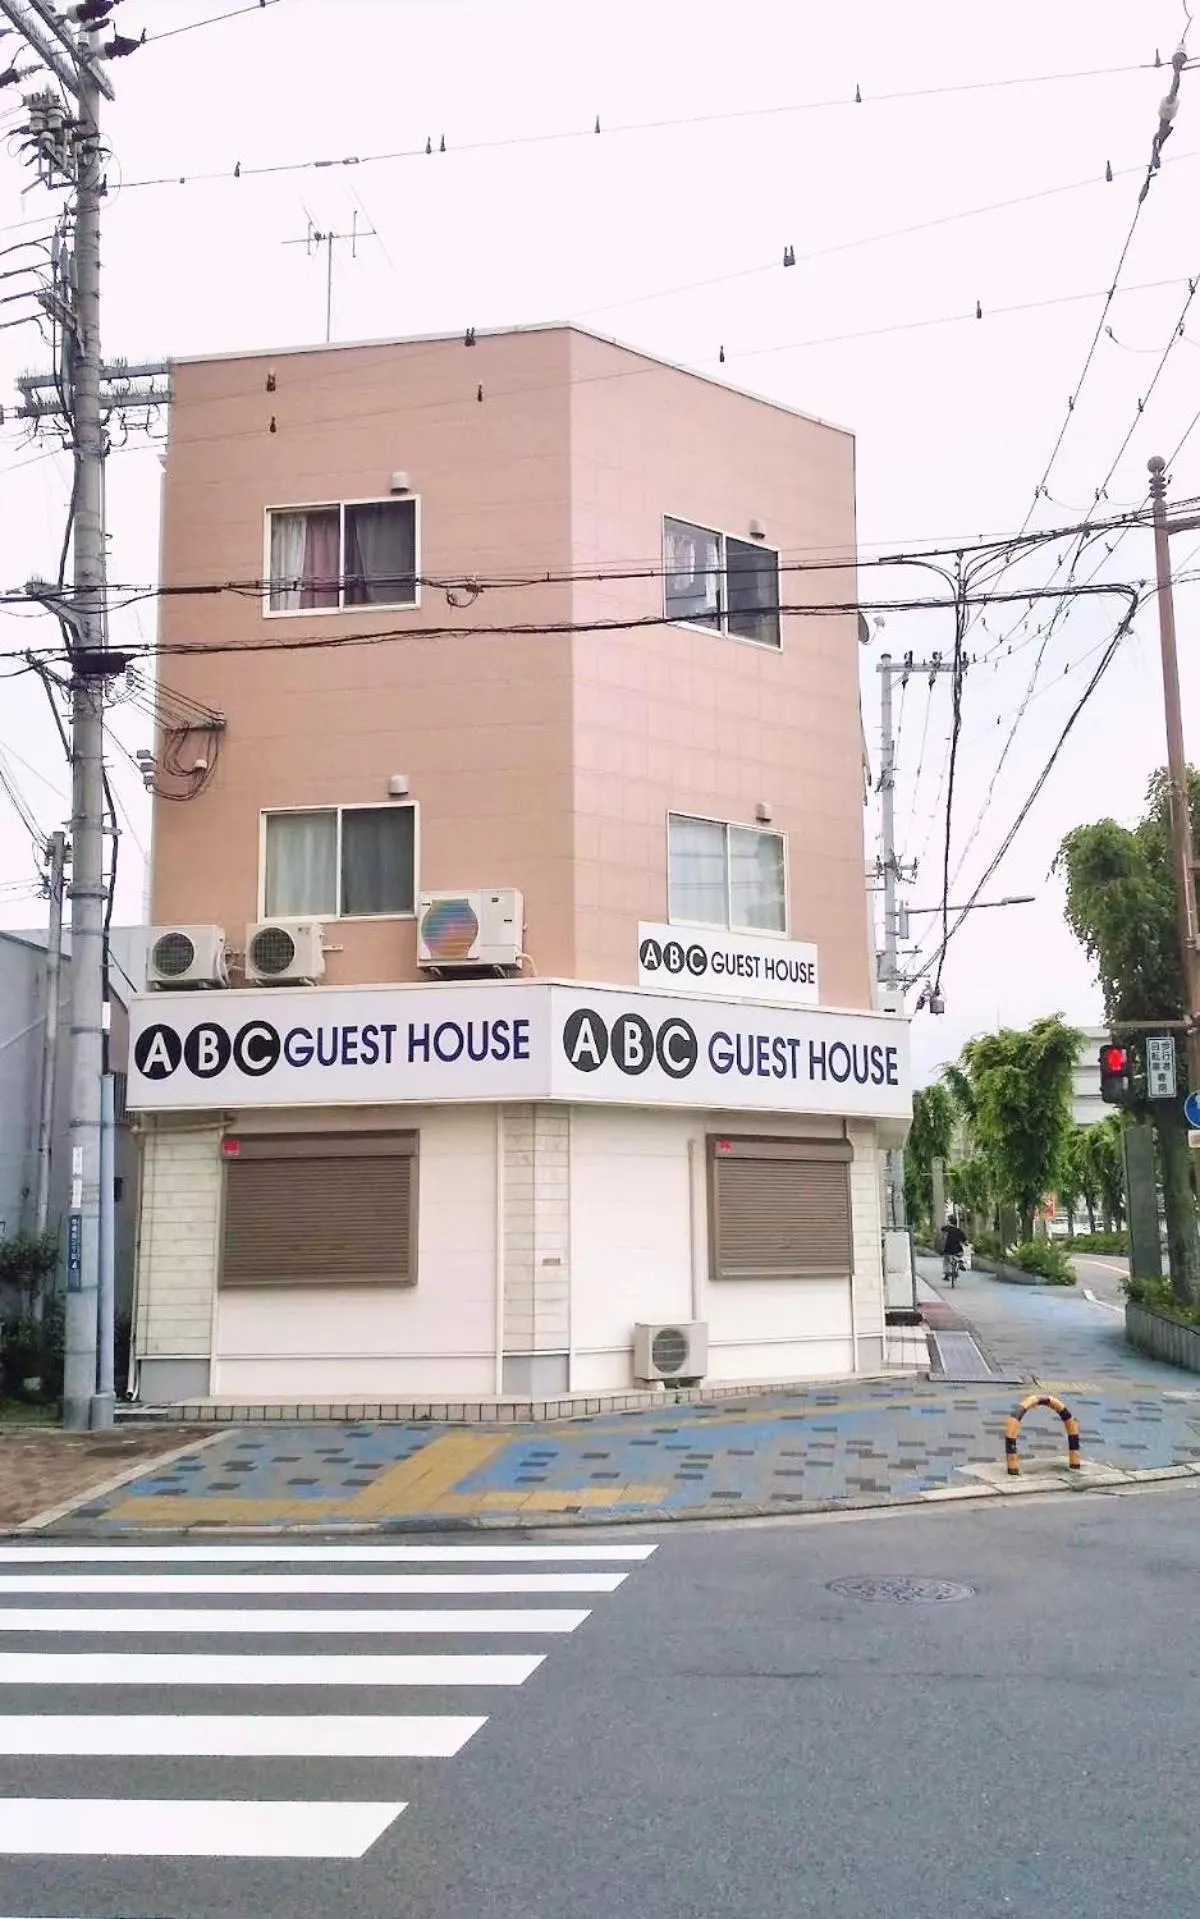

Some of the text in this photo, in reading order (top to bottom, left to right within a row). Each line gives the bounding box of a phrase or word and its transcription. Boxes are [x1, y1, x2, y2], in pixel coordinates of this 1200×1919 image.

[640, 939, 815, 984] ABC GUEST HOUSE
[135, 1019, 530, 1080] ABC GUEST HOUSE
[563, 1008, 899, 1085] ABC GUEST HOUSE
